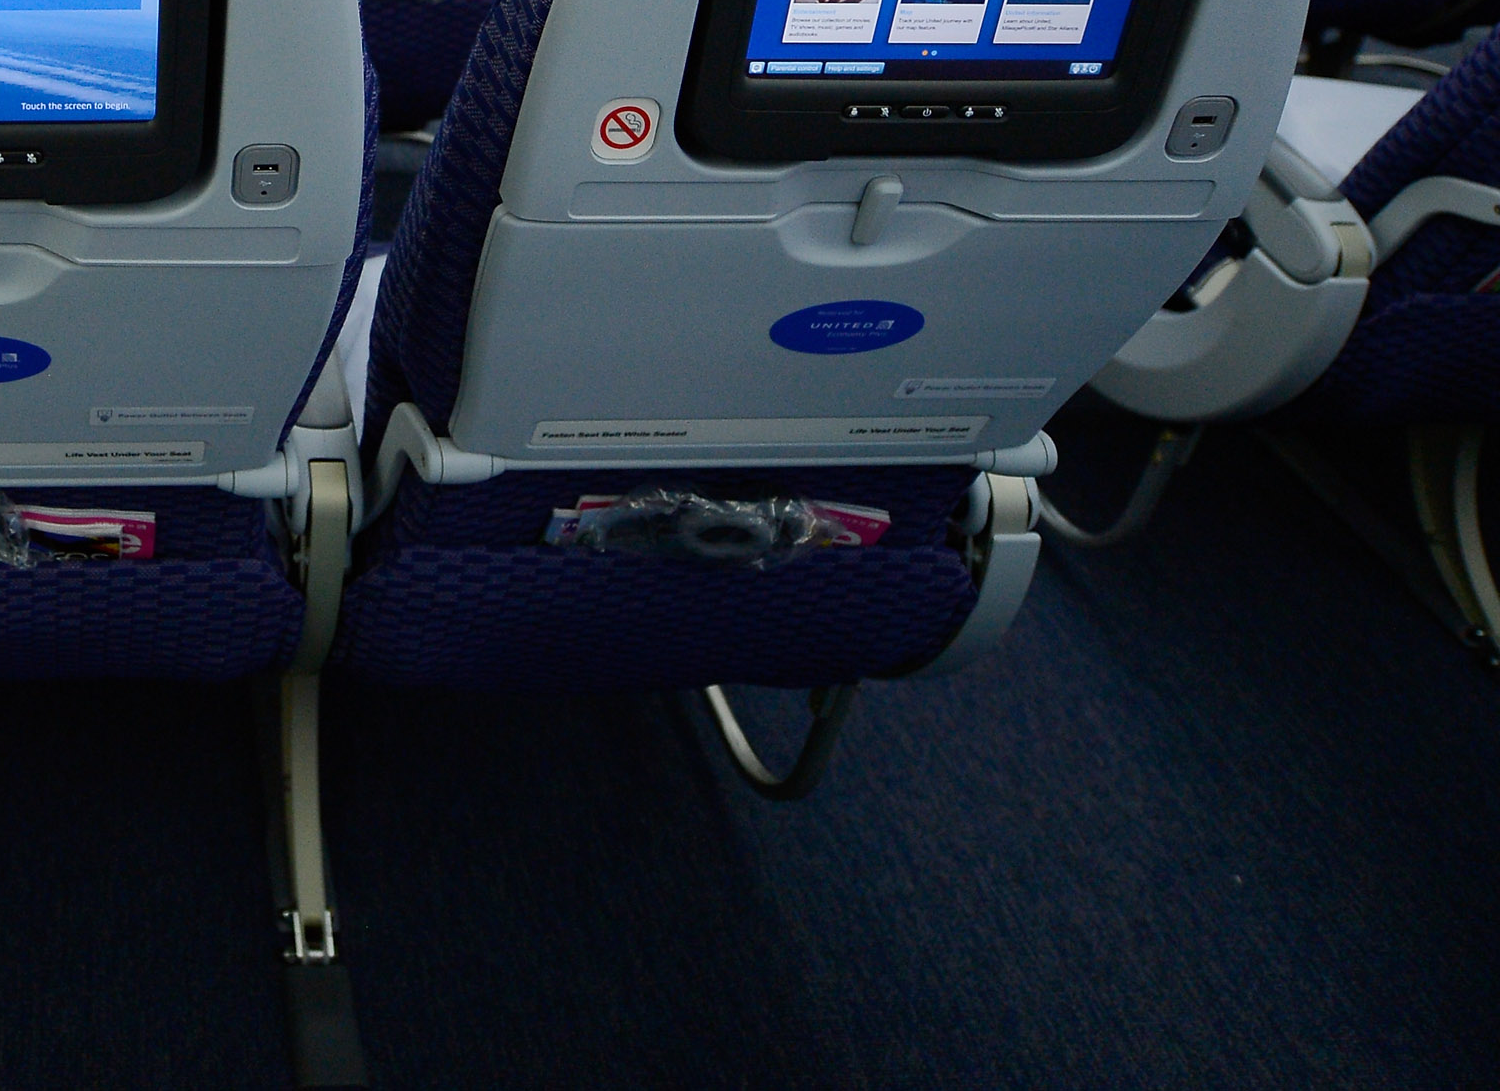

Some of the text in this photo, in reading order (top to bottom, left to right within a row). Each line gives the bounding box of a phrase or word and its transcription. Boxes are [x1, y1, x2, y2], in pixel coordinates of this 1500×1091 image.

[20, 102, 46, 110] Touch
[48, 102, 62, 110] the
[105, 102, 131, 111] begin.
